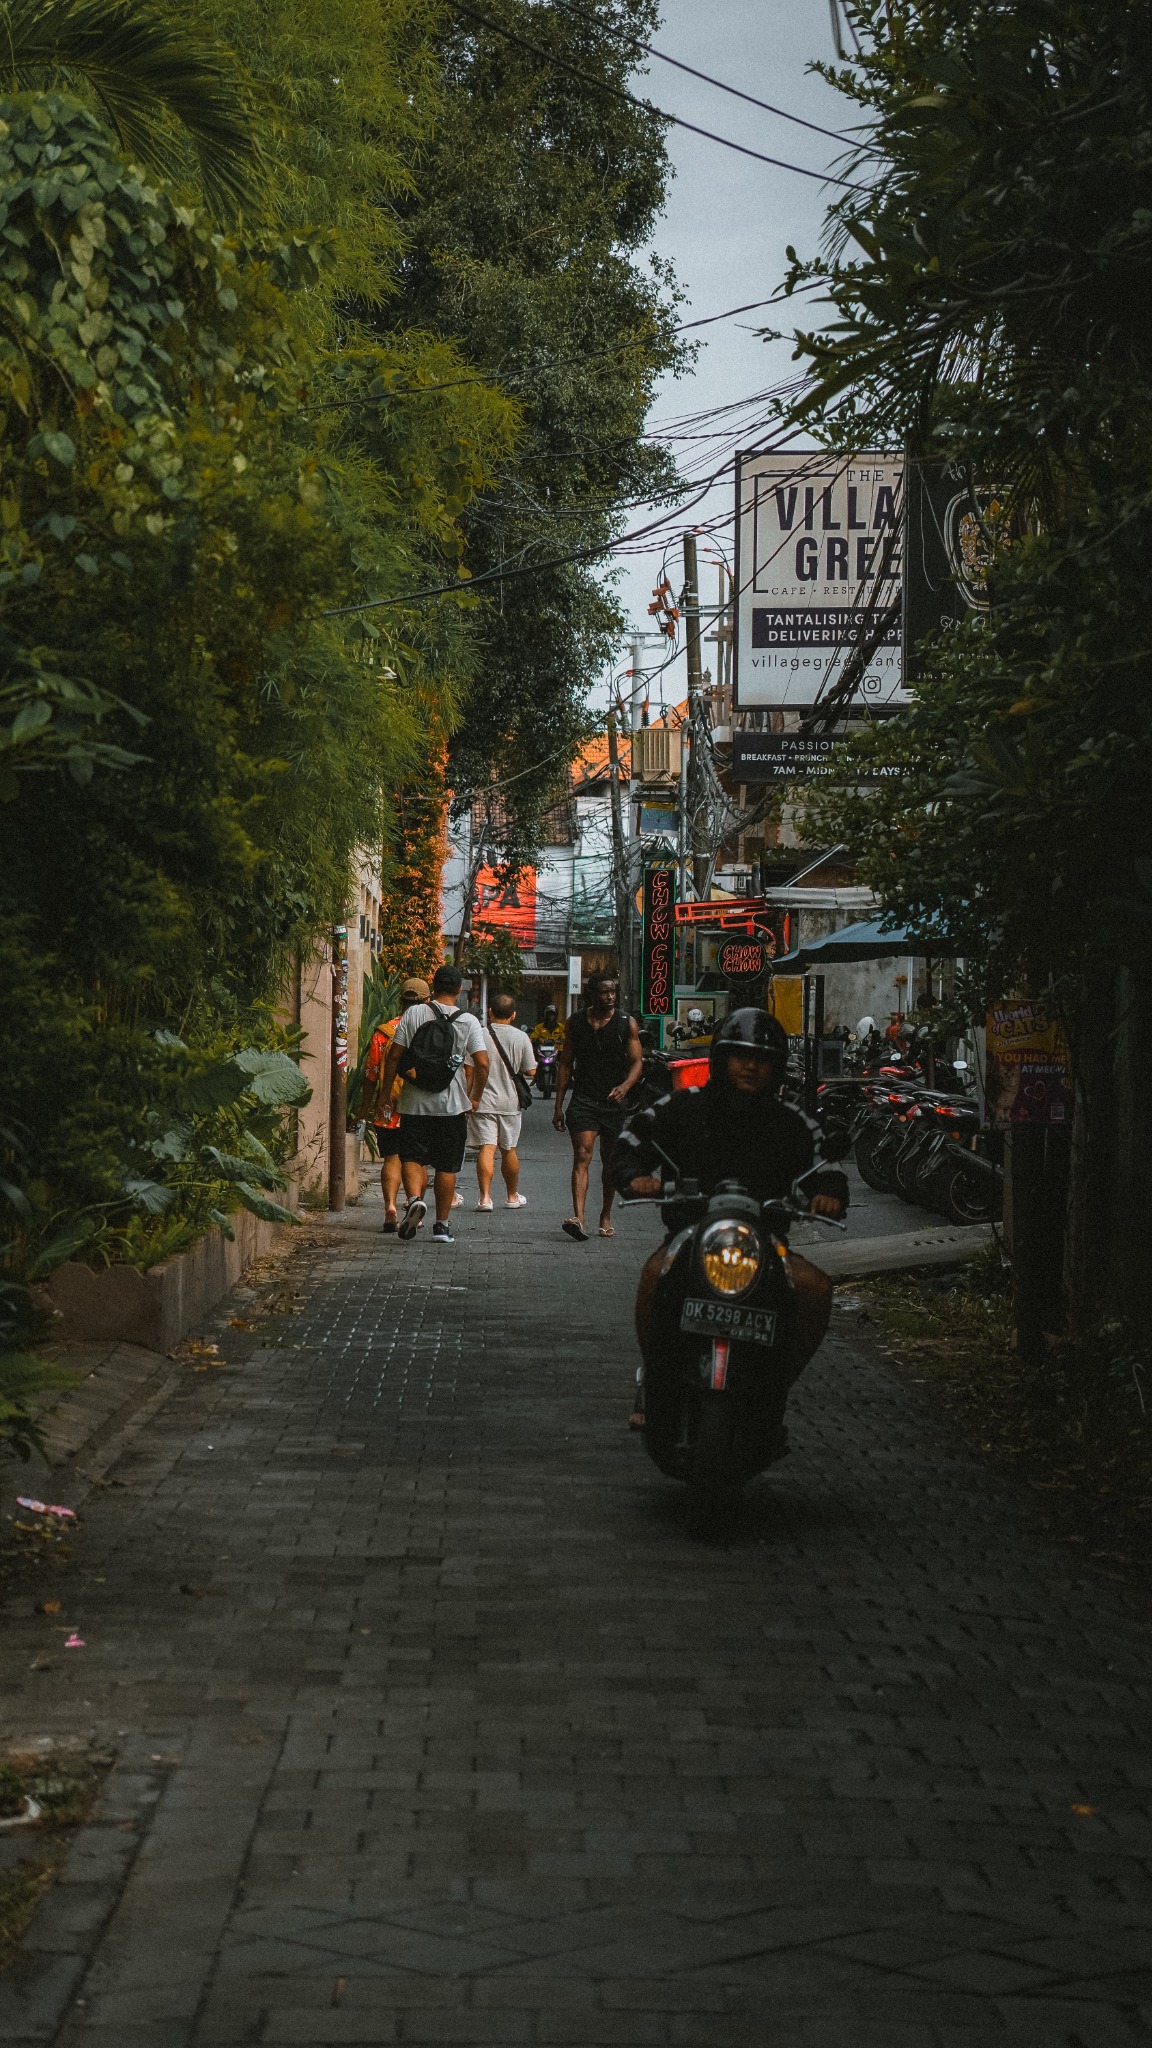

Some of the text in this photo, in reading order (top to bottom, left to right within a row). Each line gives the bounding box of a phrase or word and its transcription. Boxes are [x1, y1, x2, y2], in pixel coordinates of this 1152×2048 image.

[847, 470, 884, 482] THE
[771, 587, 806, 595] CAFE
[766, 614, 864, 626] TANTALISING
[768, 630, 859, 642] DELIVERING
[741, 753, 787, 762] BREAKFAST
[773, 766, 796, 775] 7AM
[650, 870, 670, 1014] CHOW CHOW
[723, 945, 762, 959] CHOW
[722, 958, 762, 972] CHOW
[993, 1004, 1033, 1023] World
[999, 1014, 1049, 1038] CATS
[997, 1053, 1021, 1063] YOU
[1023, 1053, 1048, 1063] HAD
[1022, 1065, 1034, 1073] AT
[685, 1301, 704, 1318] DK
[706, 1304, 742, 1325] 5298
